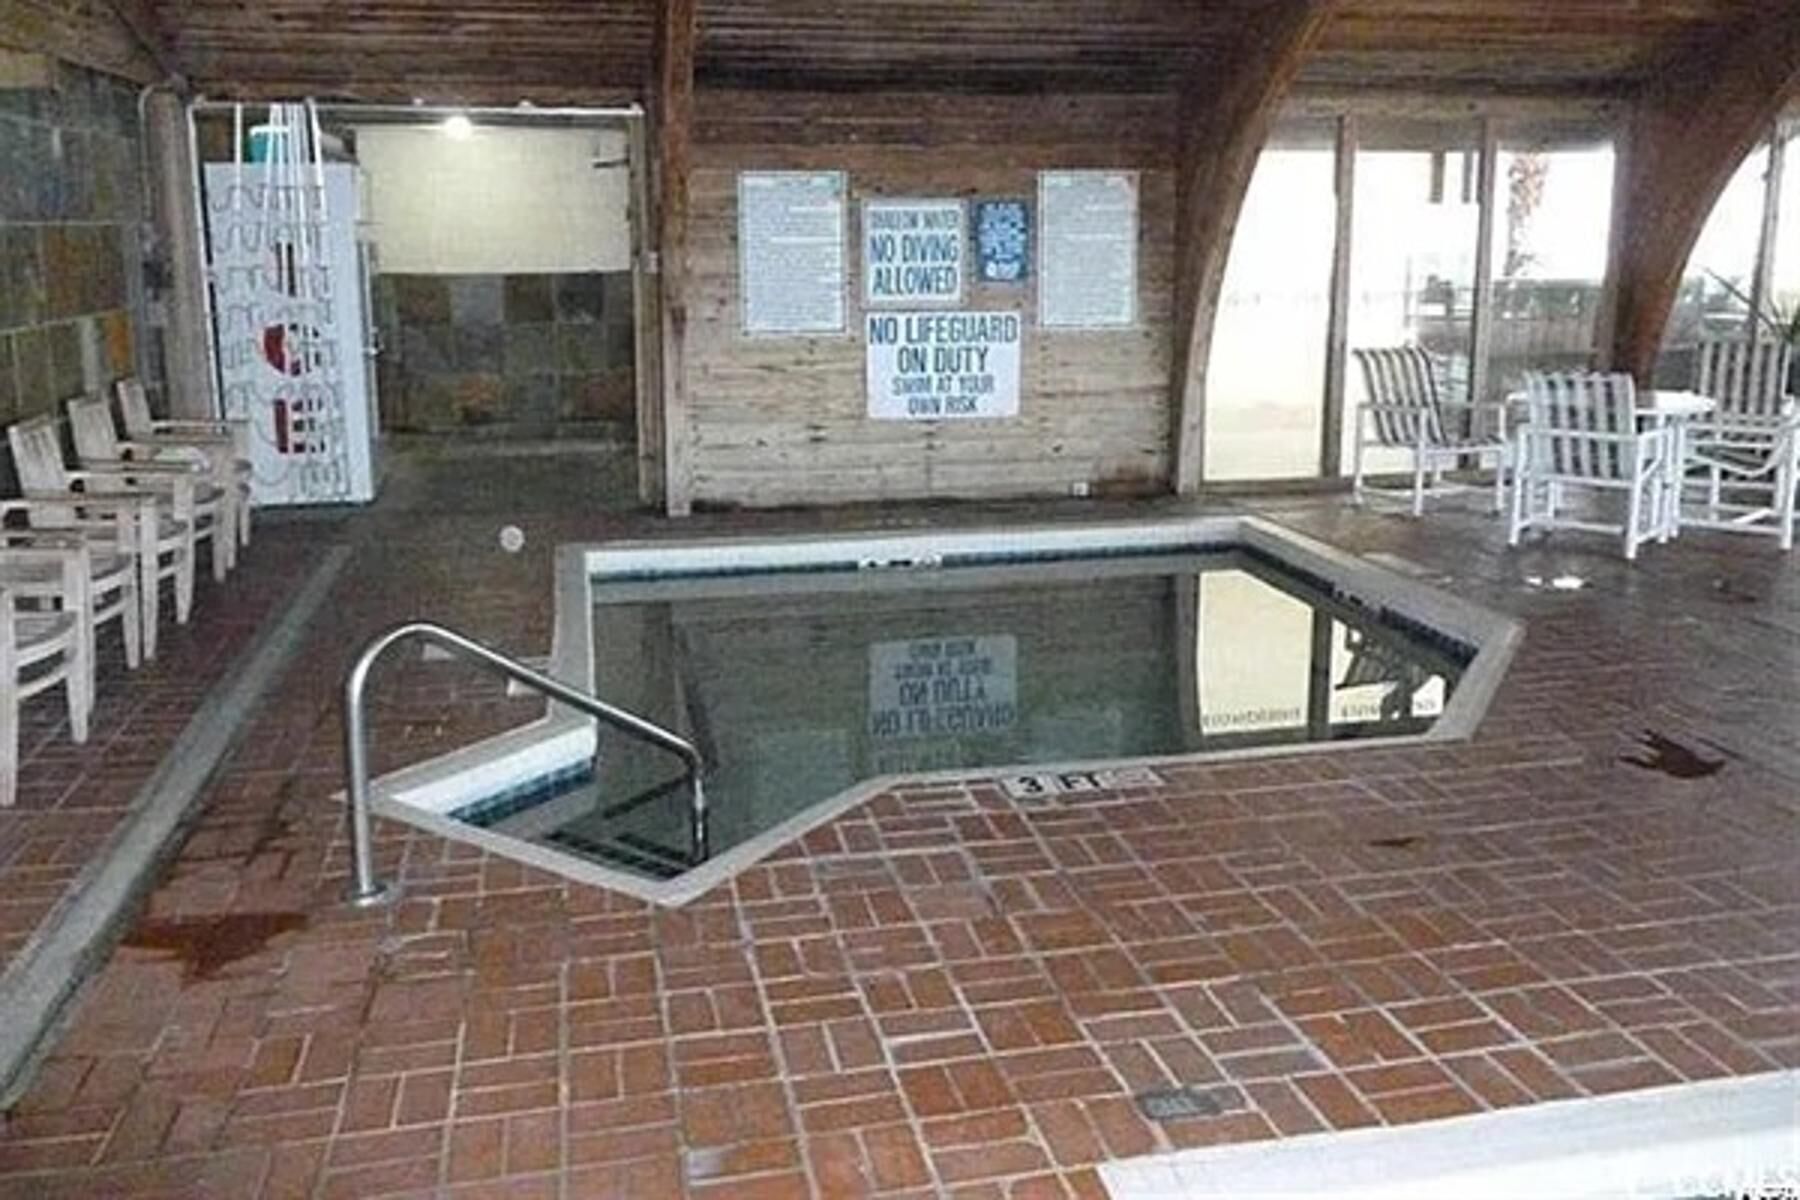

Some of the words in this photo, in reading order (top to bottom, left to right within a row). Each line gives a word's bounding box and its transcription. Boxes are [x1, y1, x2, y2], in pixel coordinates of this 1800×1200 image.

[870, 234, 895, 263] NO
[903, 233, 958, 263] DIVING
[873, 266, 957, 295] ALLOWED
[870, 317, 898, 345] NO
[906, 314, 1018, 343] LIFEGUARD
[898, 347, 927, 374] ON
[934, 346, 989, 373] DUTY
[936, 374, 953, 392] AT
[1018, 775, 1043, 793] 3
[1058, 772, 1100, 789] FT
